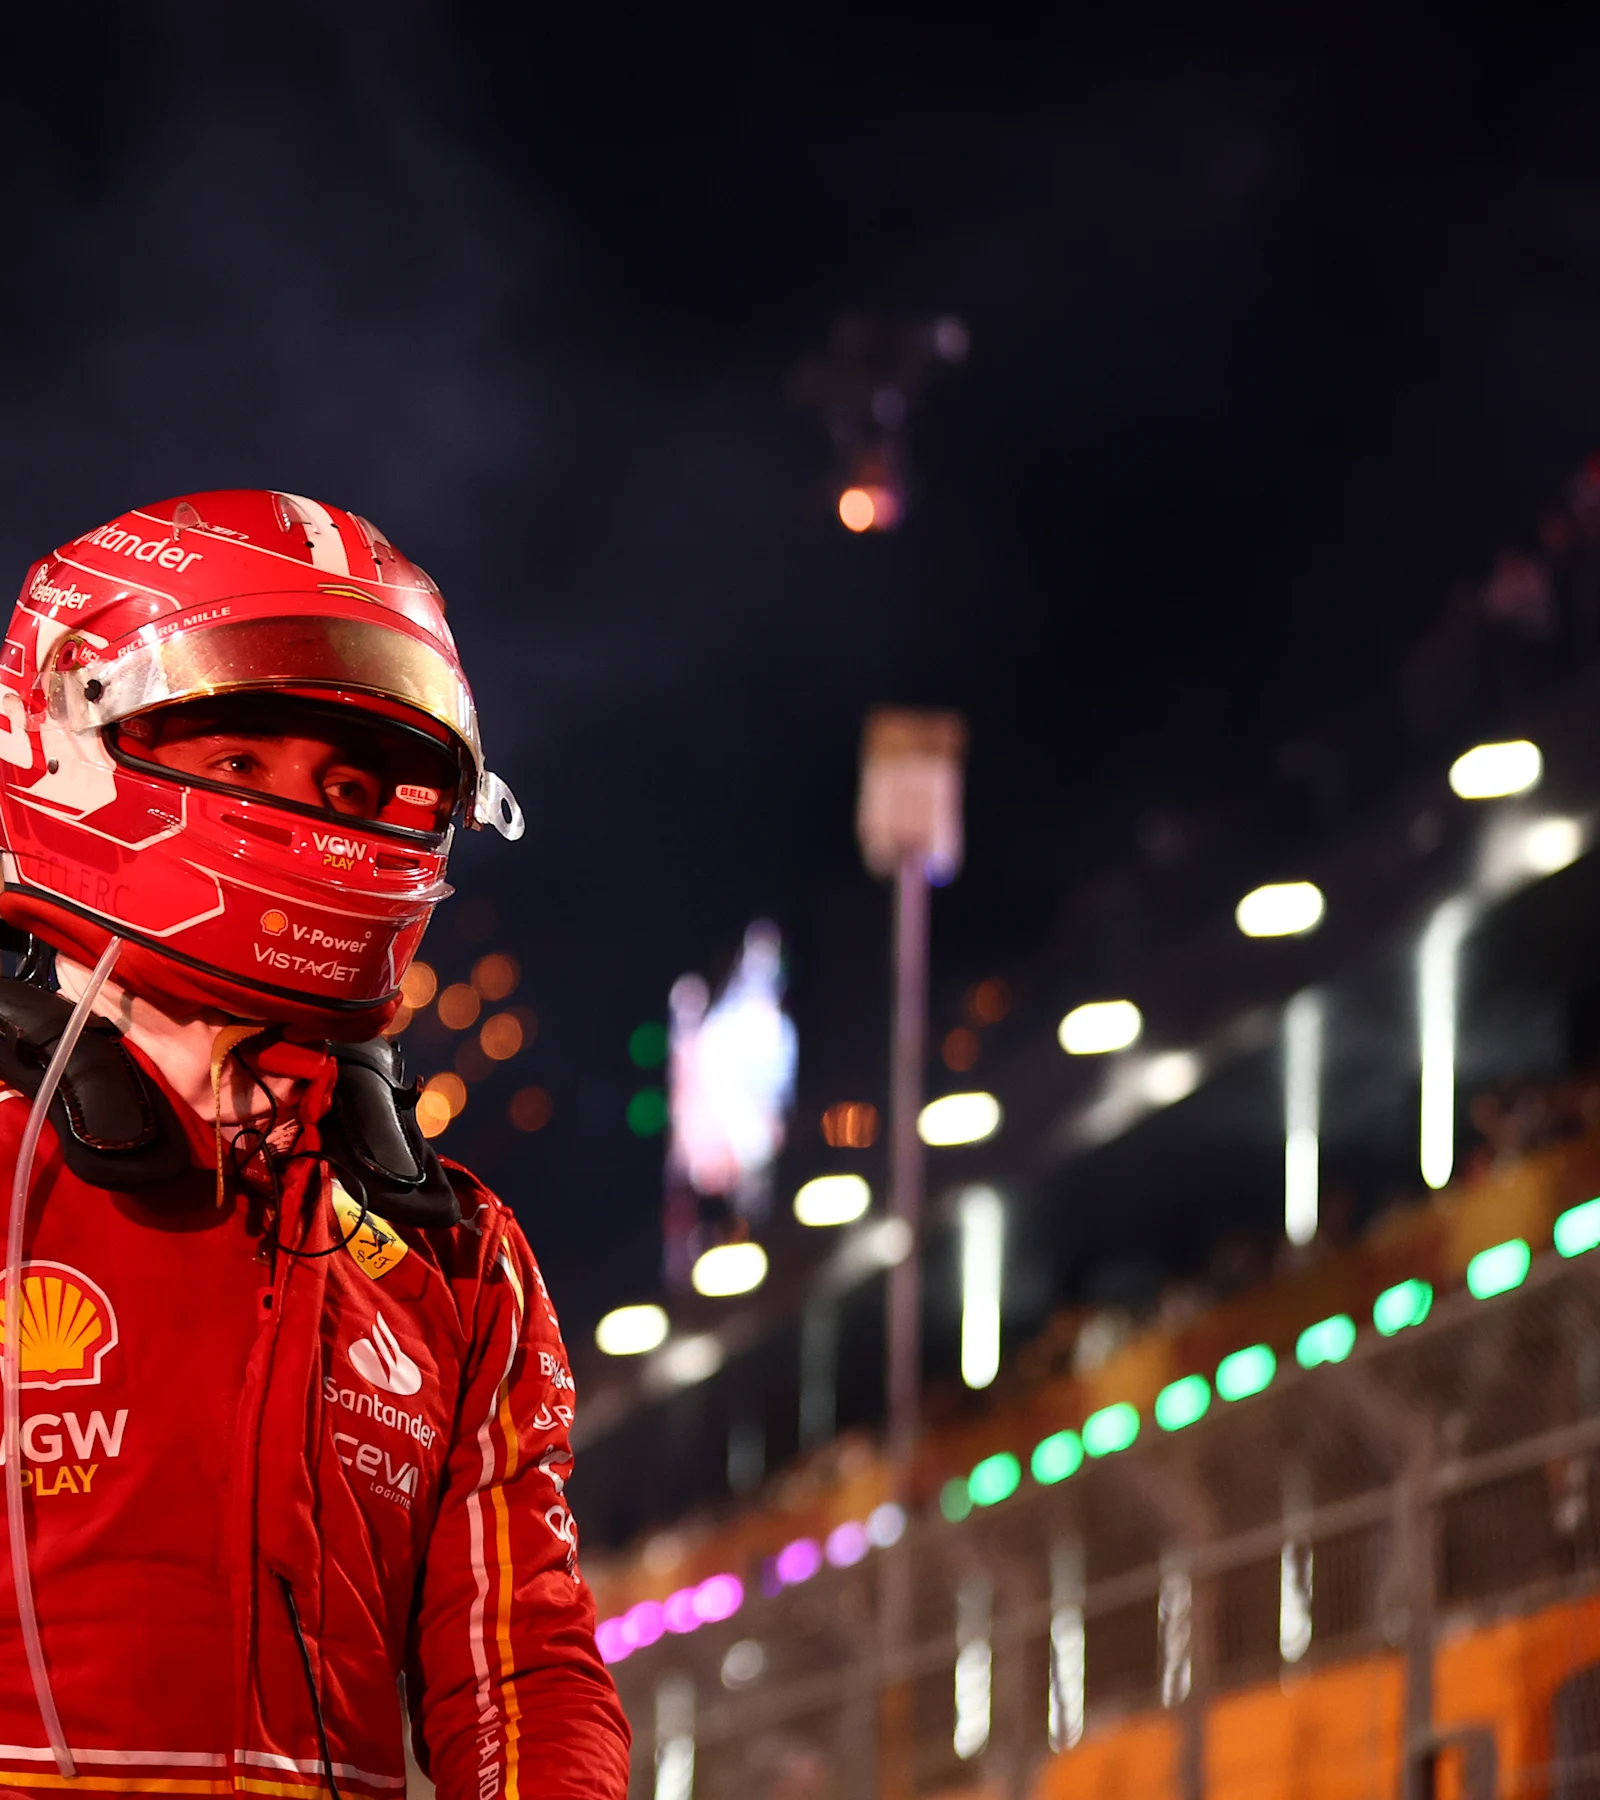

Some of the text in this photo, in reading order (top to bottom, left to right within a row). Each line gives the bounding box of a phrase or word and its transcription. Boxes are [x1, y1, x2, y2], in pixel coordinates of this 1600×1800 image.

[72, 522, 204, 574] ntander
[117, 606, 231, 659] RICHRD MILLE
[400, 786, 431, 801] BELL
[311, 831, 368, 861] VGW
[322, 853, 355, 871] PLAY
[292, 923, 368, 953] V-Power
[323, 1376, 436, 1451] Santander
[17, 1463, 99, 1497] PLAY
[369, 1480, 410, 1510] LOGISTIC
